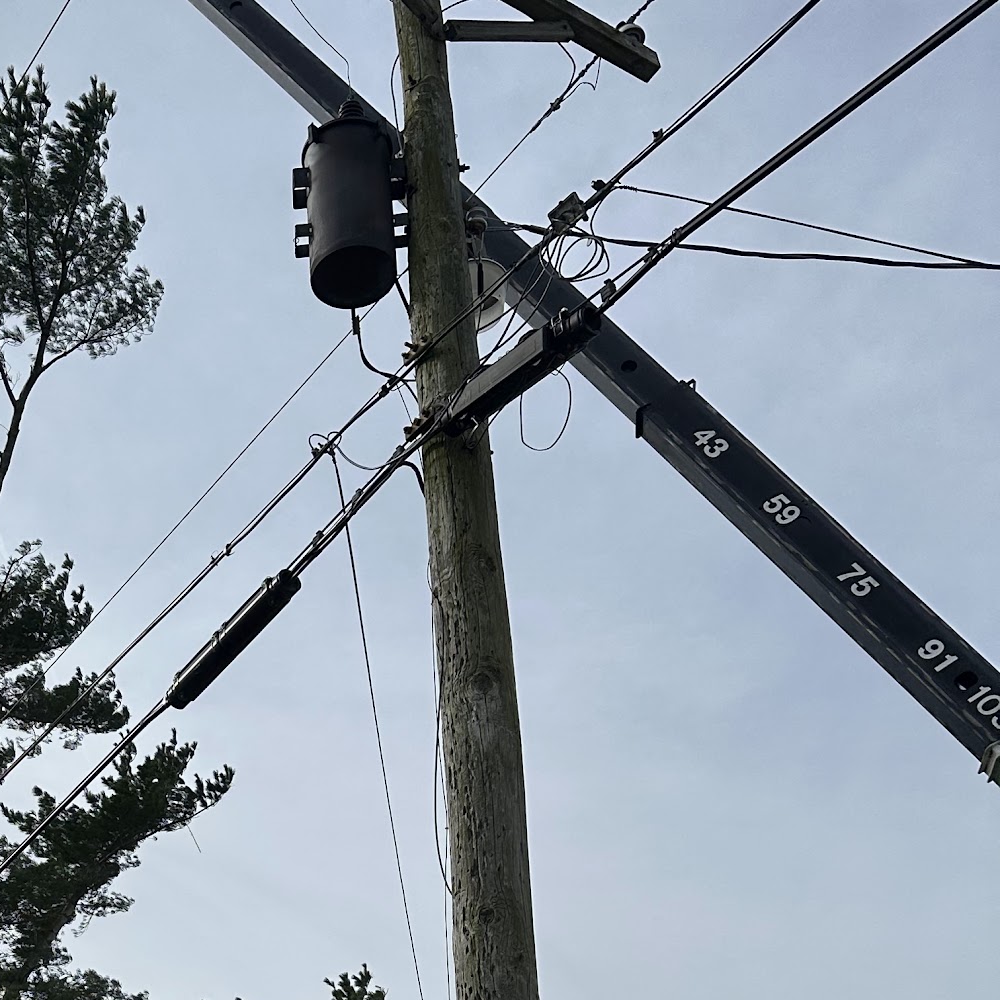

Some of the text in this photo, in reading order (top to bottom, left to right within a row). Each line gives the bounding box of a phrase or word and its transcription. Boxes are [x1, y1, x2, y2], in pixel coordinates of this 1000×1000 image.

[693, 429, 730, 458] 43
[763, 493, 801, 525] 59
[836, 562, 880, 597] 75
[917, 639, 959, 673] 91
